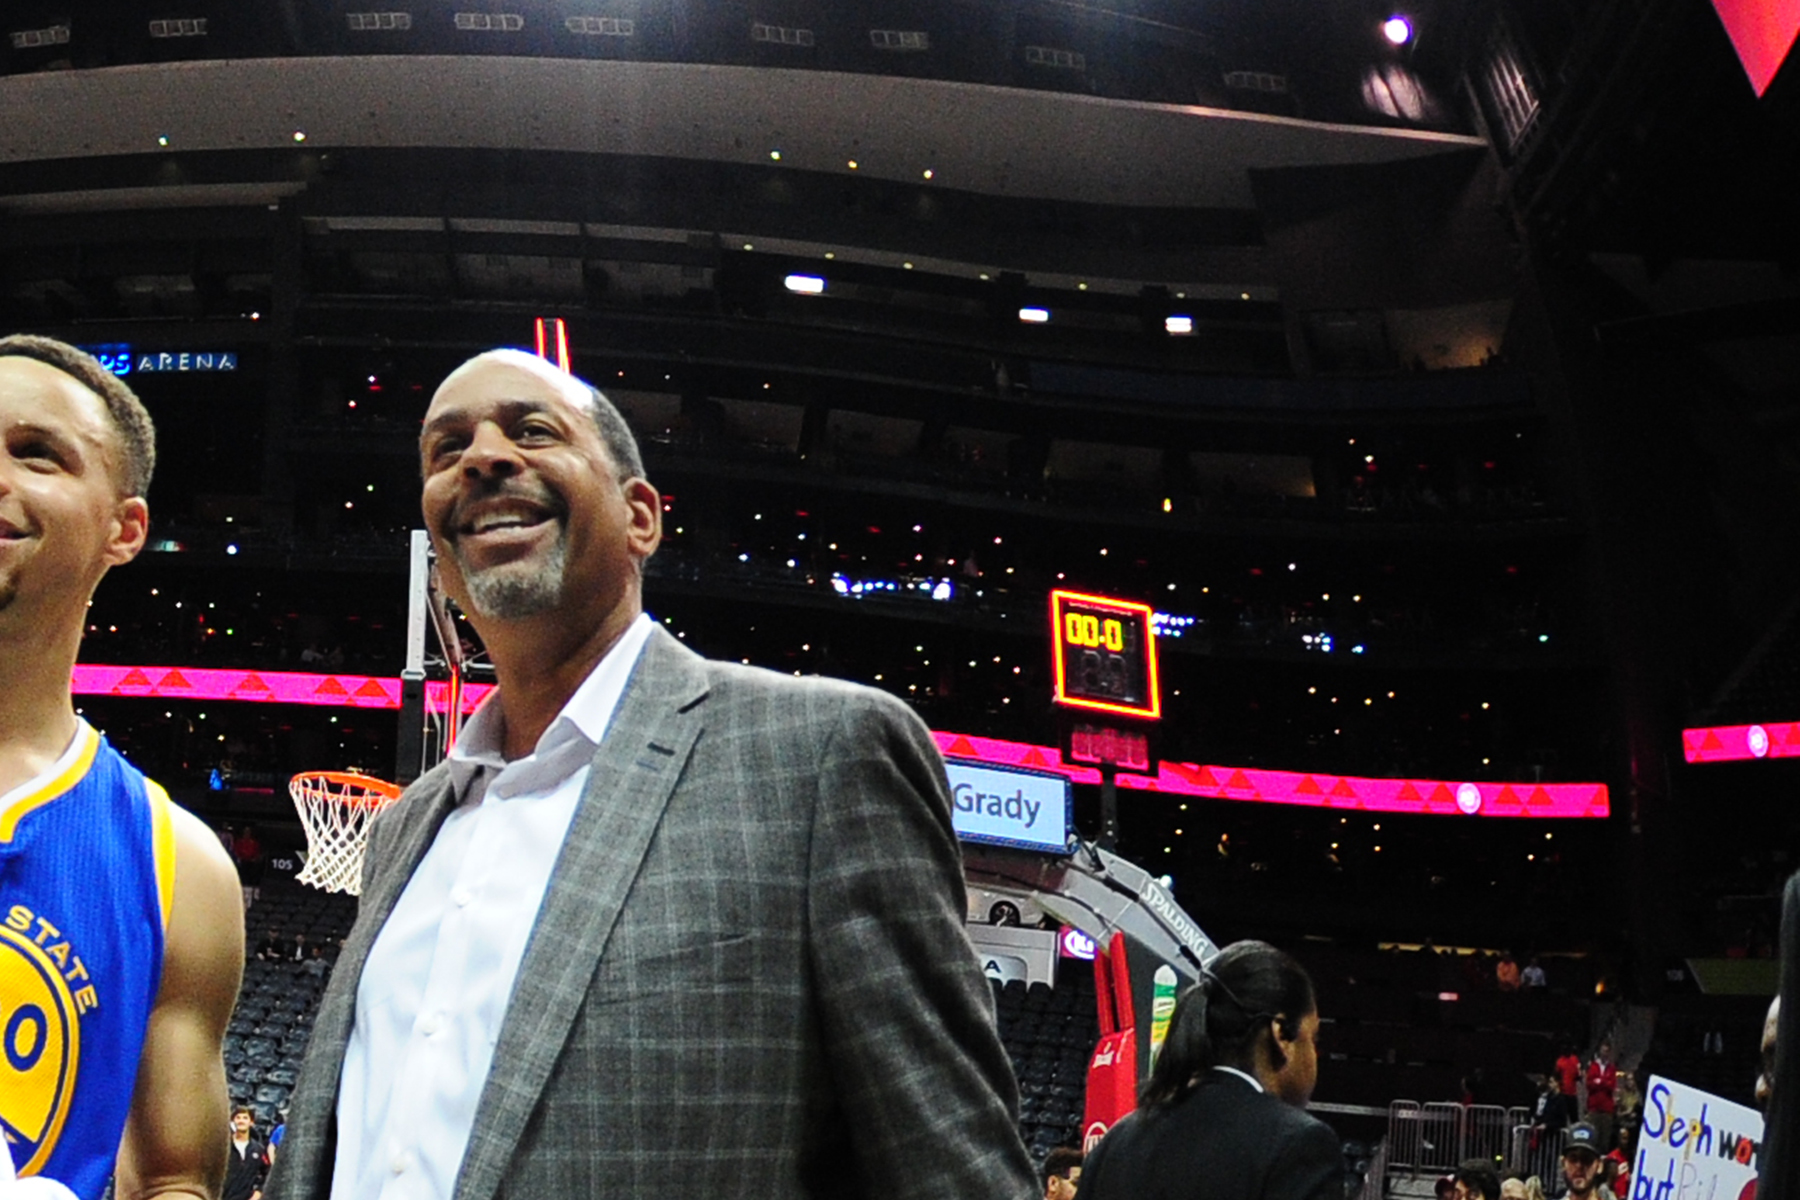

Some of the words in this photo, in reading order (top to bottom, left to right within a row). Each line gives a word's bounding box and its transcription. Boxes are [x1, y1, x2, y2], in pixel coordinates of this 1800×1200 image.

[138, 352, 234, 371] ARENA
[953, 783, 1041, 828] Grady
[271, 858, 293, 870] 105
[1140, 883, 1208, 955] SPALDING
[5, 904, 98, 1015] STATE
[1643, 1083, 1713, 1161] Steph
